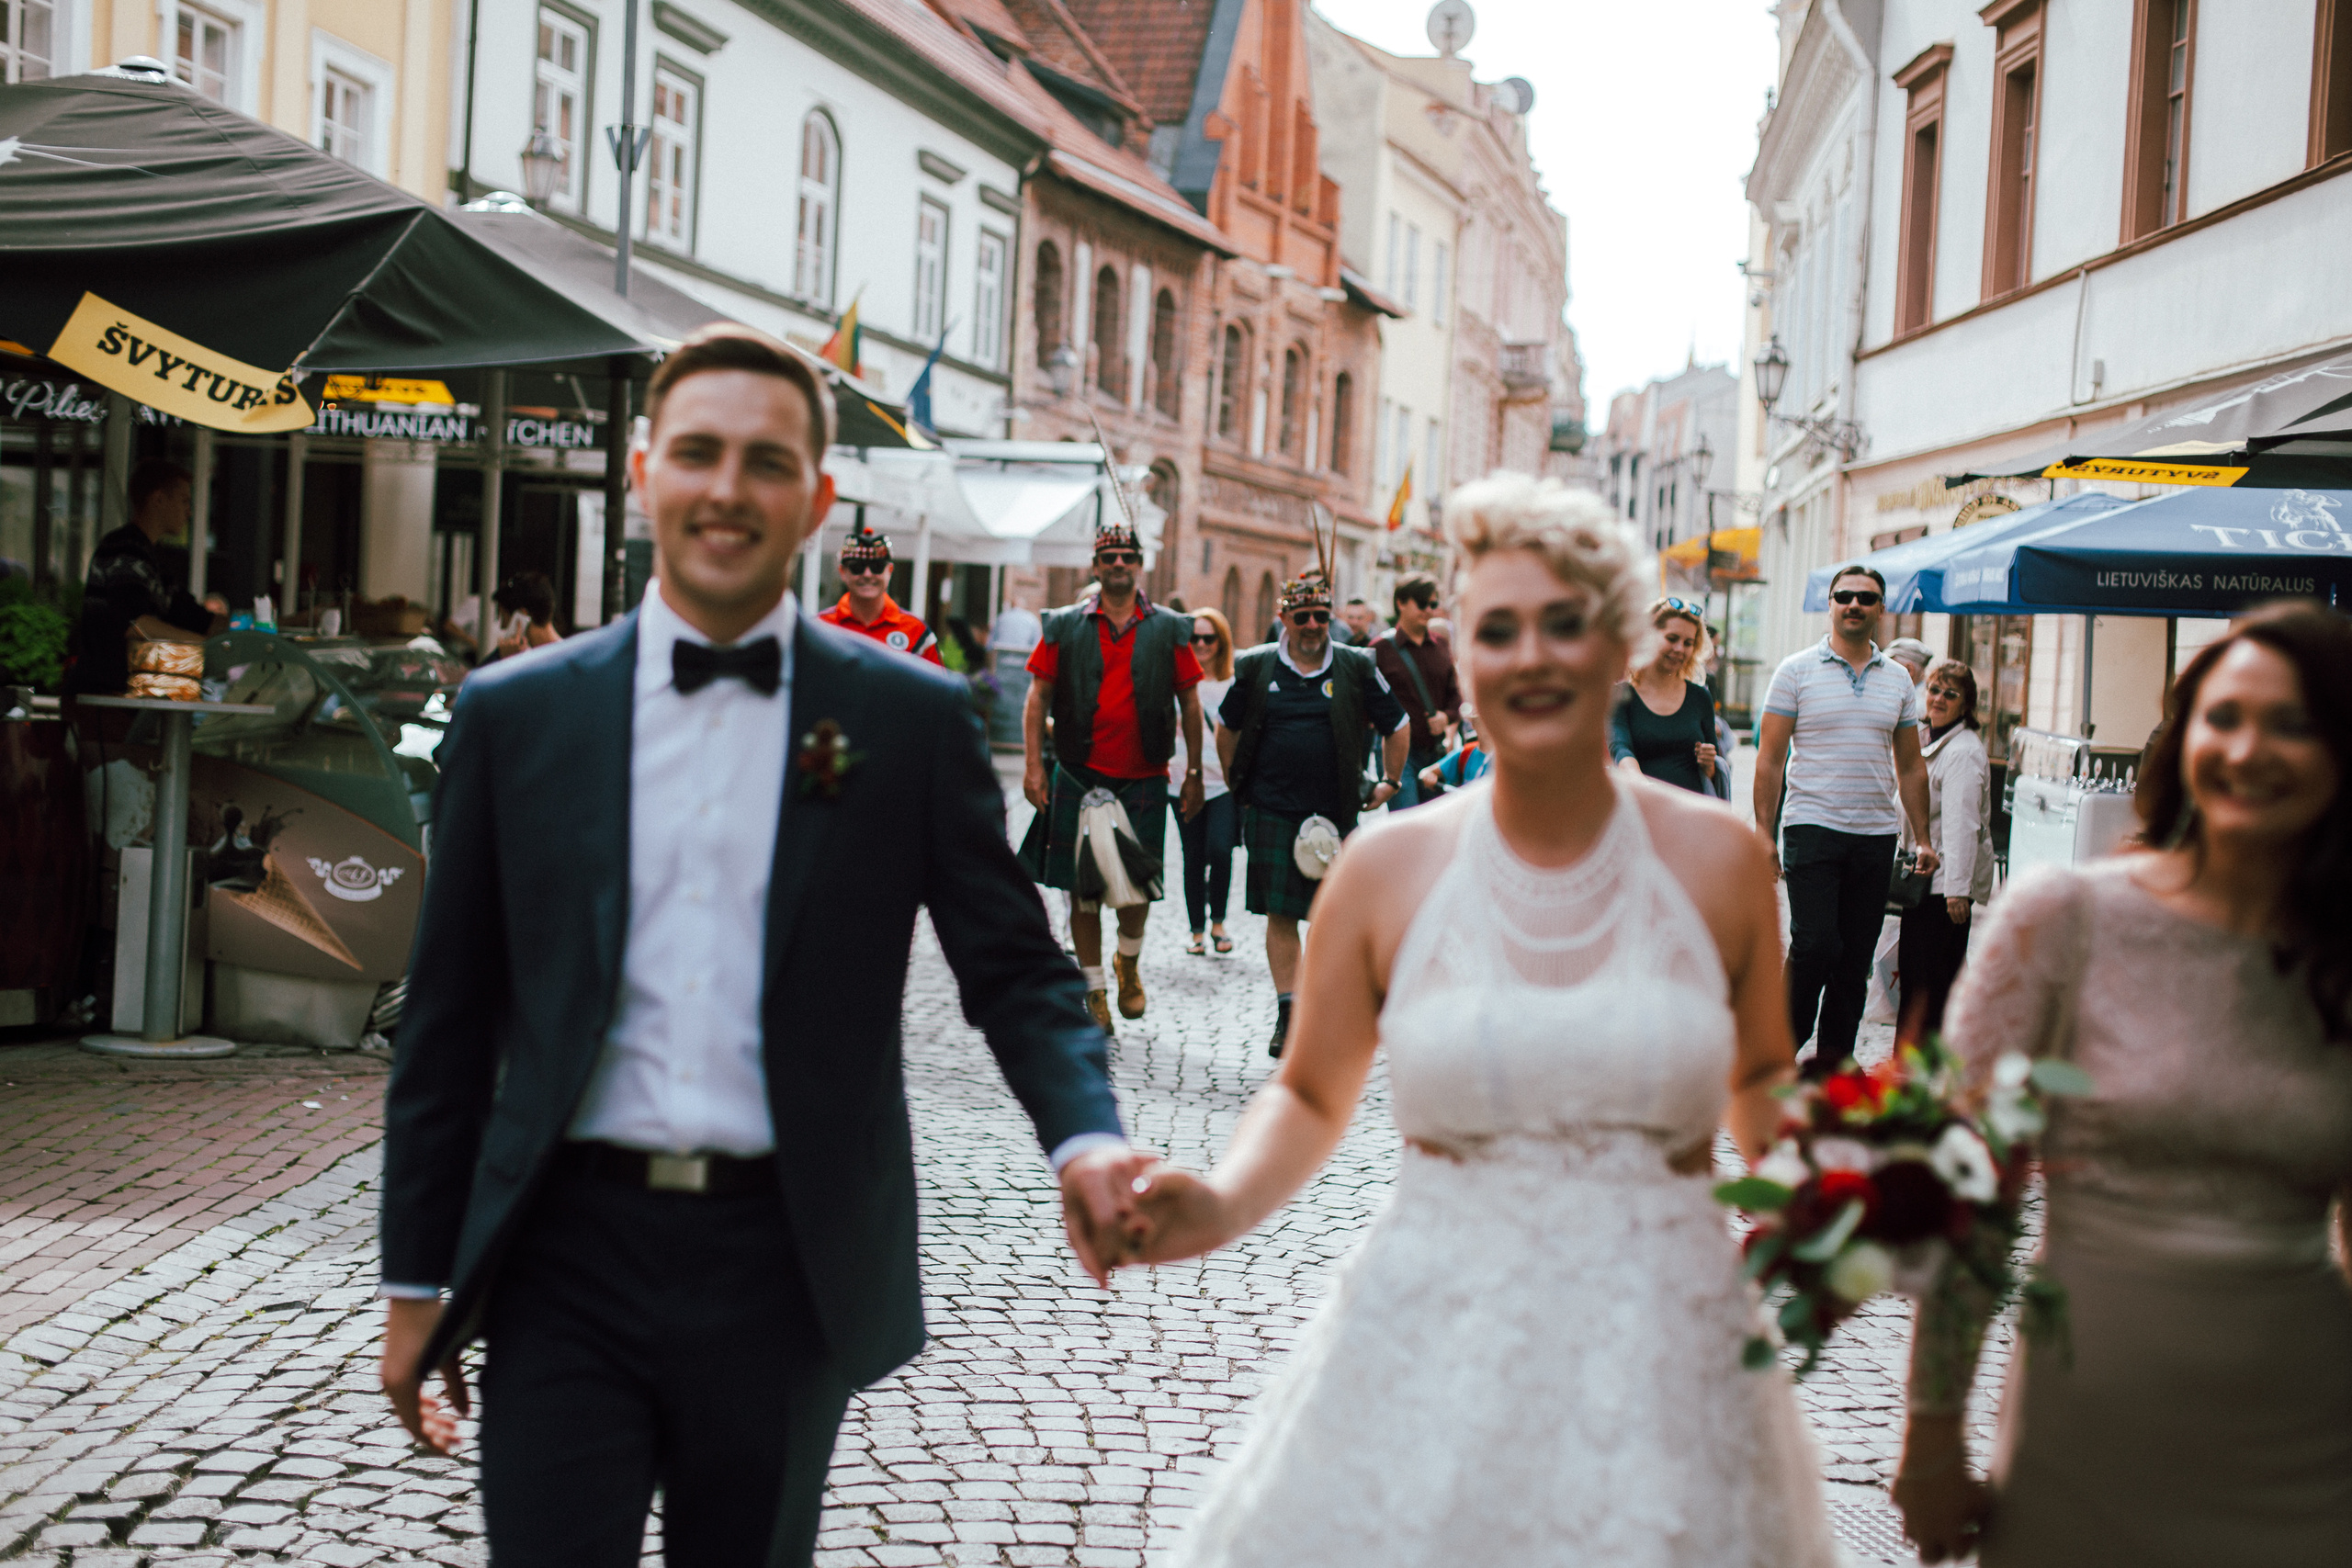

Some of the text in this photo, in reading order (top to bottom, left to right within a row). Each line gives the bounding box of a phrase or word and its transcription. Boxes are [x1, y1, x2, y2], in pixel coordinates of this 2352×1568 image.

[96, 321, 297, 411] ŠVYTURS
[2189, 524, 2352, 552] TIC
[2097, 570, 2315, 593] LIETUVIŠKAS NATŪRALUS
